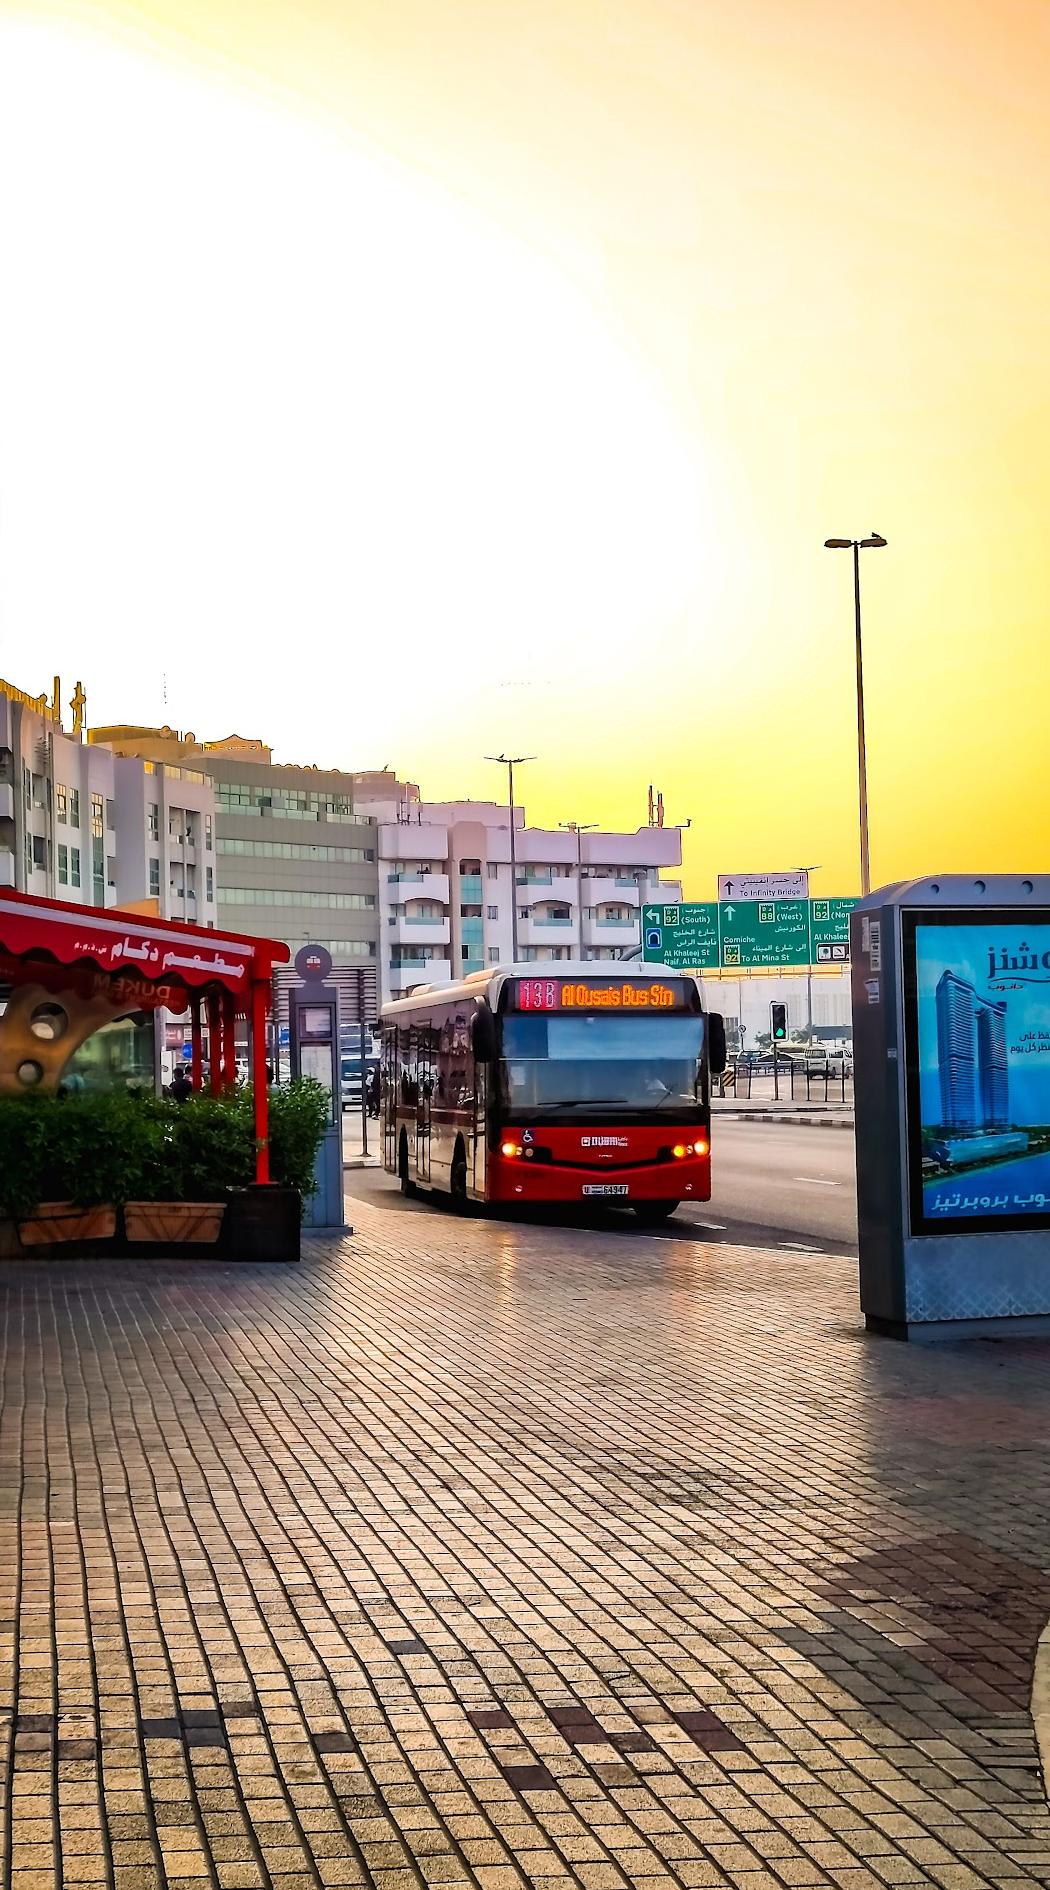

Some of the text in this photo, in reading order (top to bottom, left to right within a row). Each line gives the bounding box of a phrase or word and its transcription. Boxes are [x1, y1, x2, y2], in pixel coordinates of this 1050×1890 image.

[750, 889, 776, 897] Infinity
[778, 888, 800, 896] Bridge
[665, 915, 677, 923] 92
[761, 912, 773, 920] 88
[776, 912, 803, 921] (West)
[816, 911, 828, 919] 92
[681, 916, 711, 925] (South)
[698, 928, 716, 937] شارع
[813, 932, 849, 941] Al Khalee
[723, 936, 756, 944] Corniche
[775, 944, 794, 952] شارع
[673, 949, 700, 957] Khaleej
[725, 954, 737, 962] 92
[162, 951, 245, 978] مطعم
[561, 984, 575, 1006] Al
[622, 984, 648, 1006] Bus
[650, 984, 675, 1006] Stn
